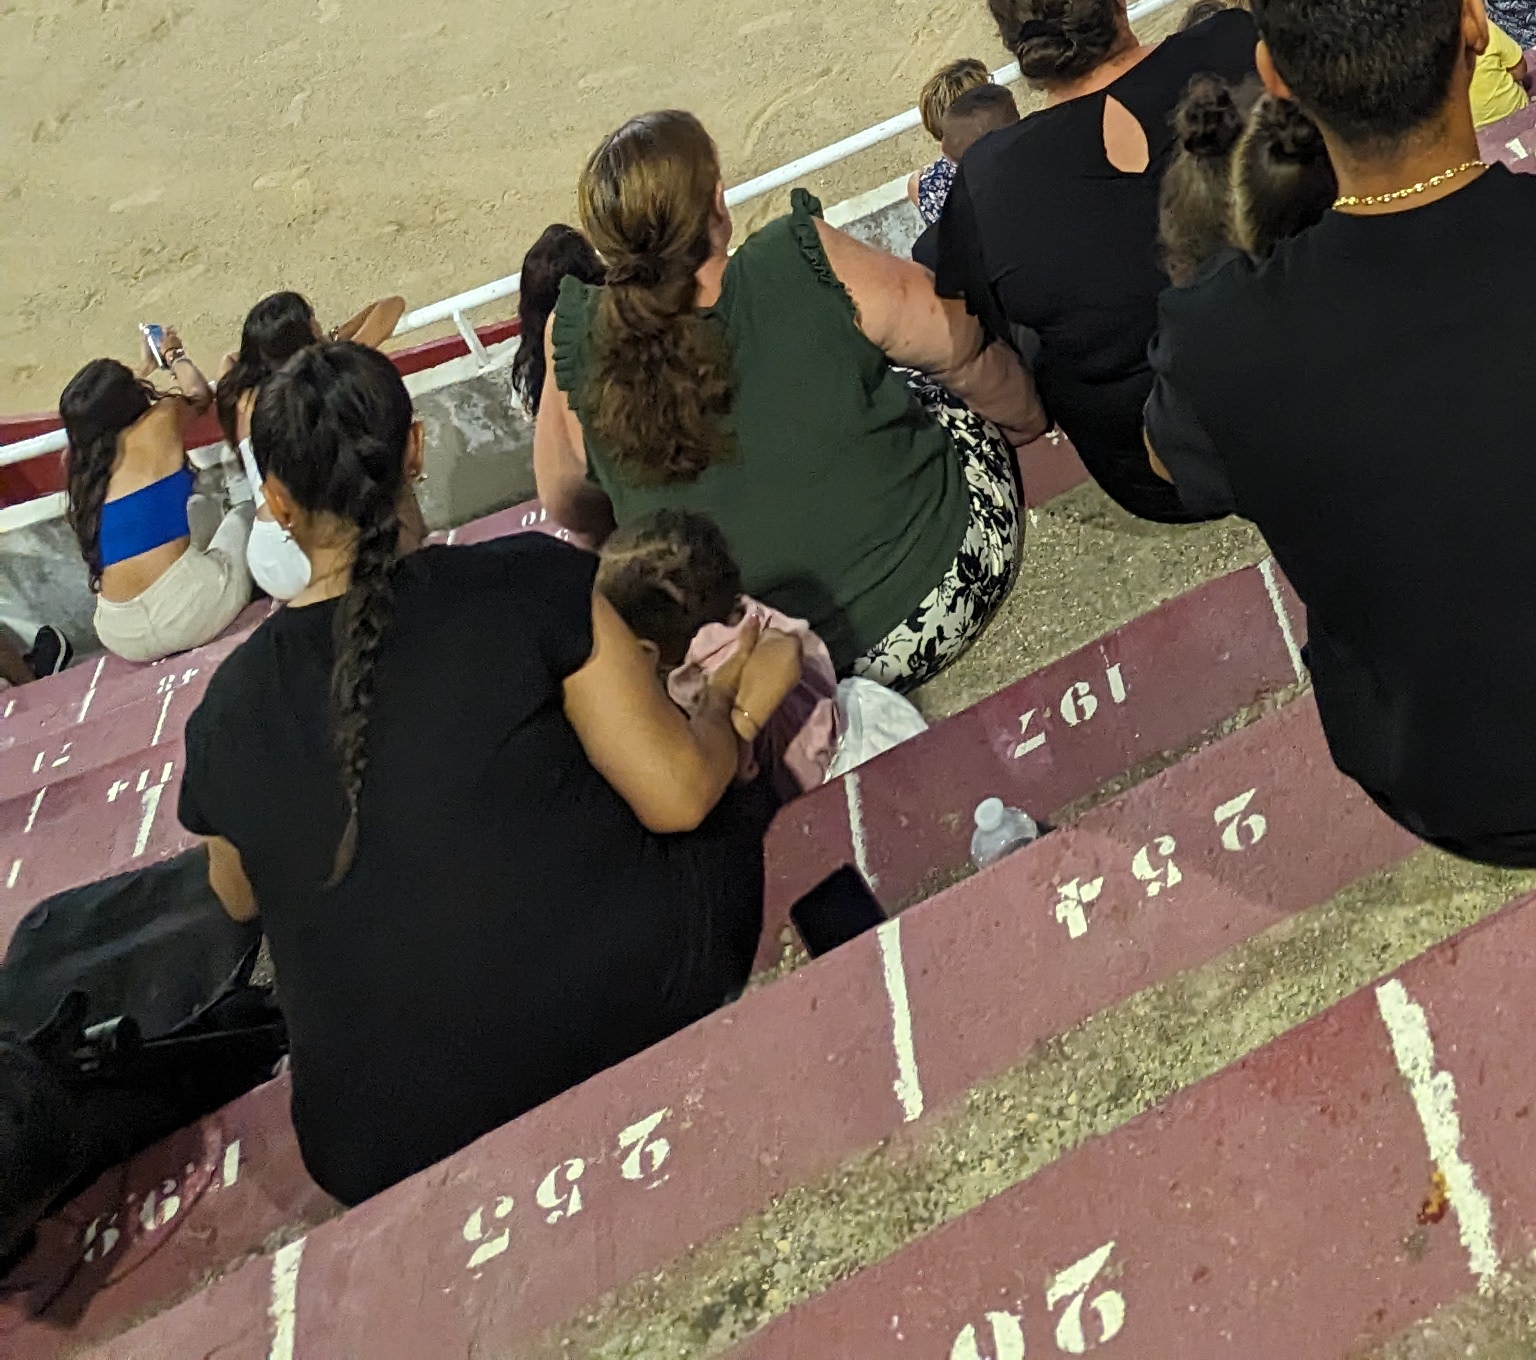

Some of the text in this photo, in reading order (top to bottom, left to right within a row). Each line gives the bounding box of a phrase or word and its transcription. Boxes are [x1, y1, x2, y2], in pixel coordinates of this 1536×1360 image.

[1012, 662, 1127, 759] 197
[1053, 787, 1268, 941] 254
[462, 1105, 672, 1270] 255
